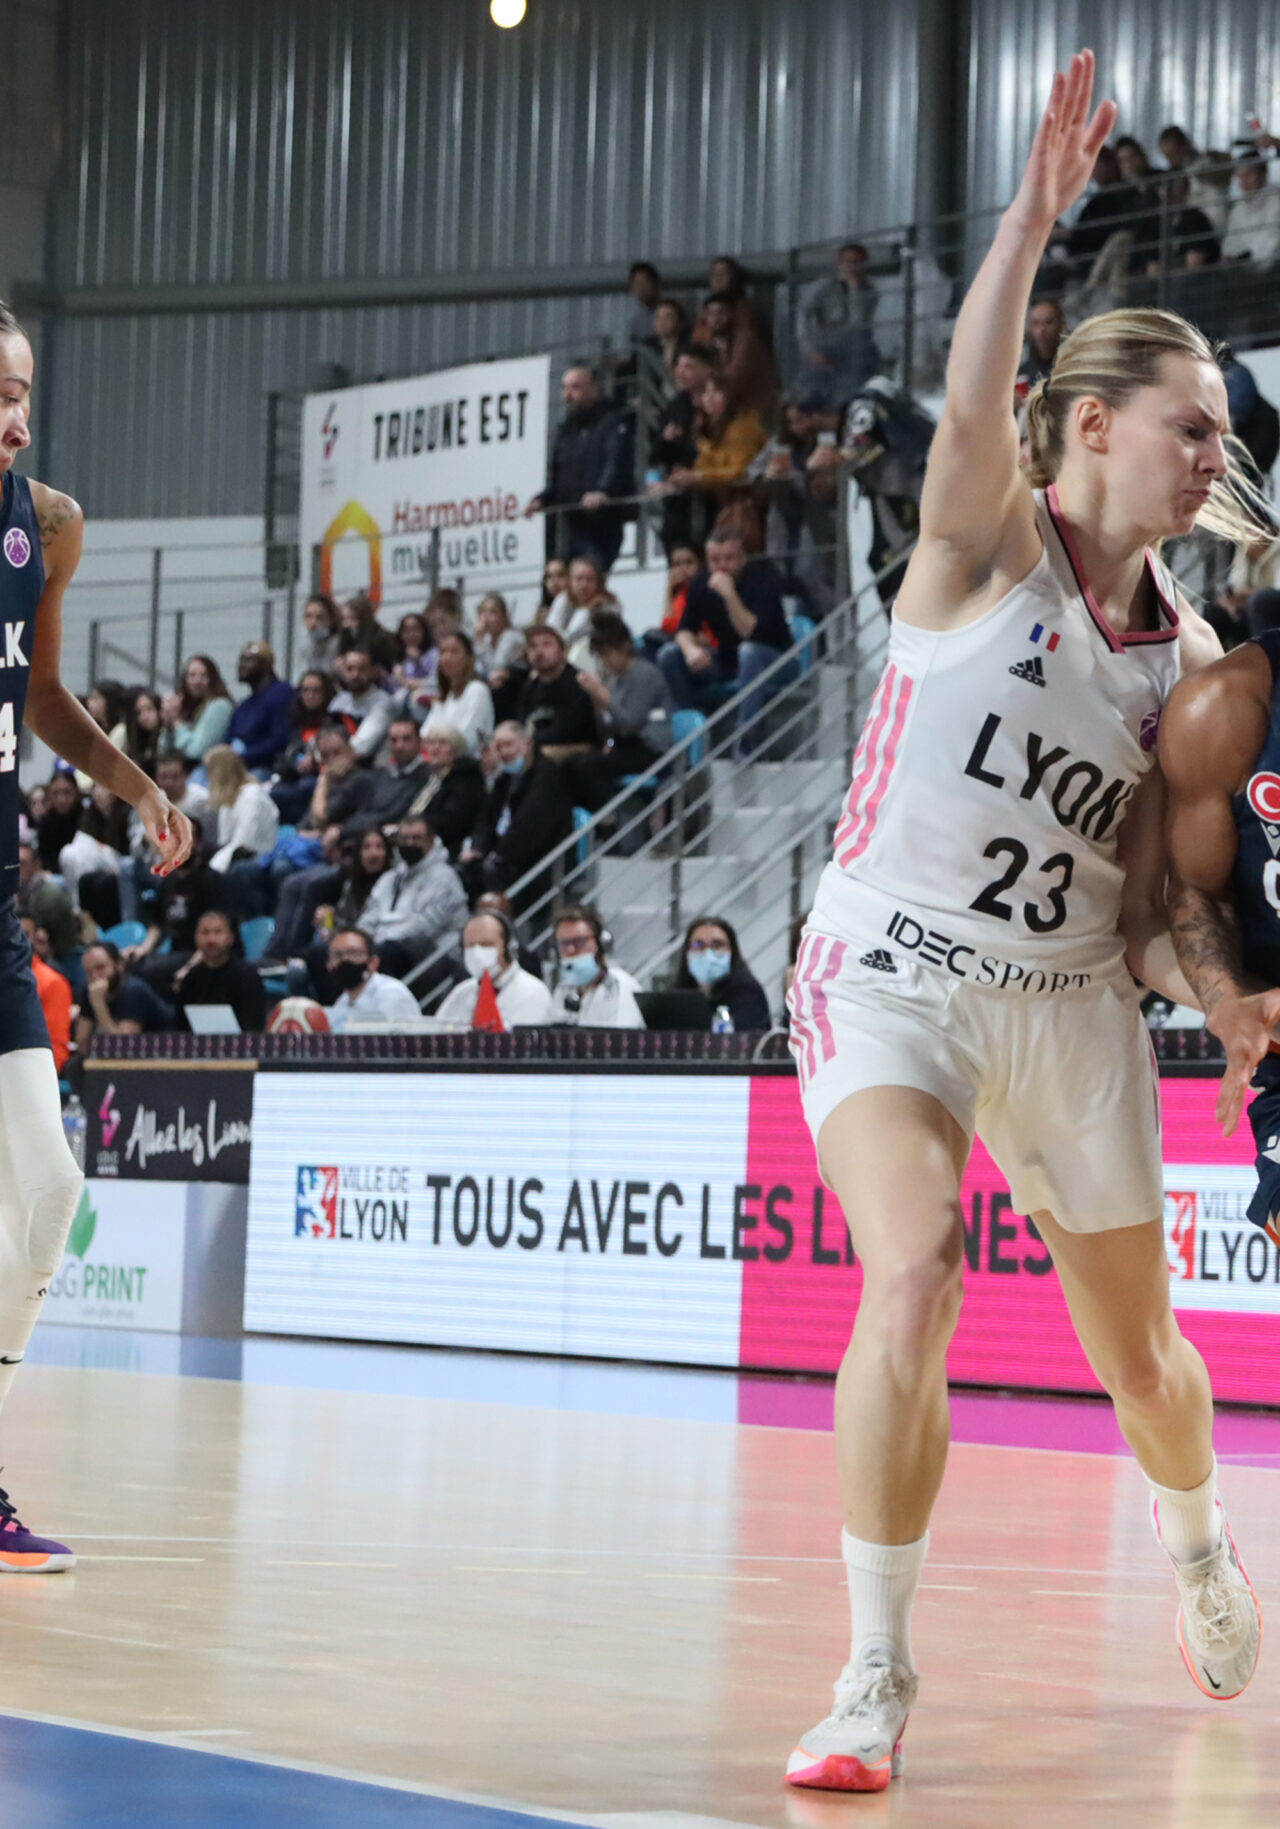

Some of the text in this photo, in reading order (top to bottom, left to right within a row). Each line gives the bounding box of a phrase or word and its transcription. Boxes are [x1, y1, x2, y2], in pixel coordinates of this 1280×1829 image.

[374, 390, 529, 463] TRIBUNE EST
[392, 487, 519, 534] Harmonie
[392, 529, 519, 574] muelle
[964, 712, 1137, 841] LYON
[968, 836, 1075, 934] 23
[886, 910, 1092, 993] IDEC SPORT
[341, 1166, 409, 1193] VILLE DE
[340, 1198, 408, 1243] LYON
[426, 1174, 1055, 1276] TOUS AVEC LES LNES
[1201, 1191, 1247, 1221] VILL
[82, 1264, 147, 1301] PRINT
